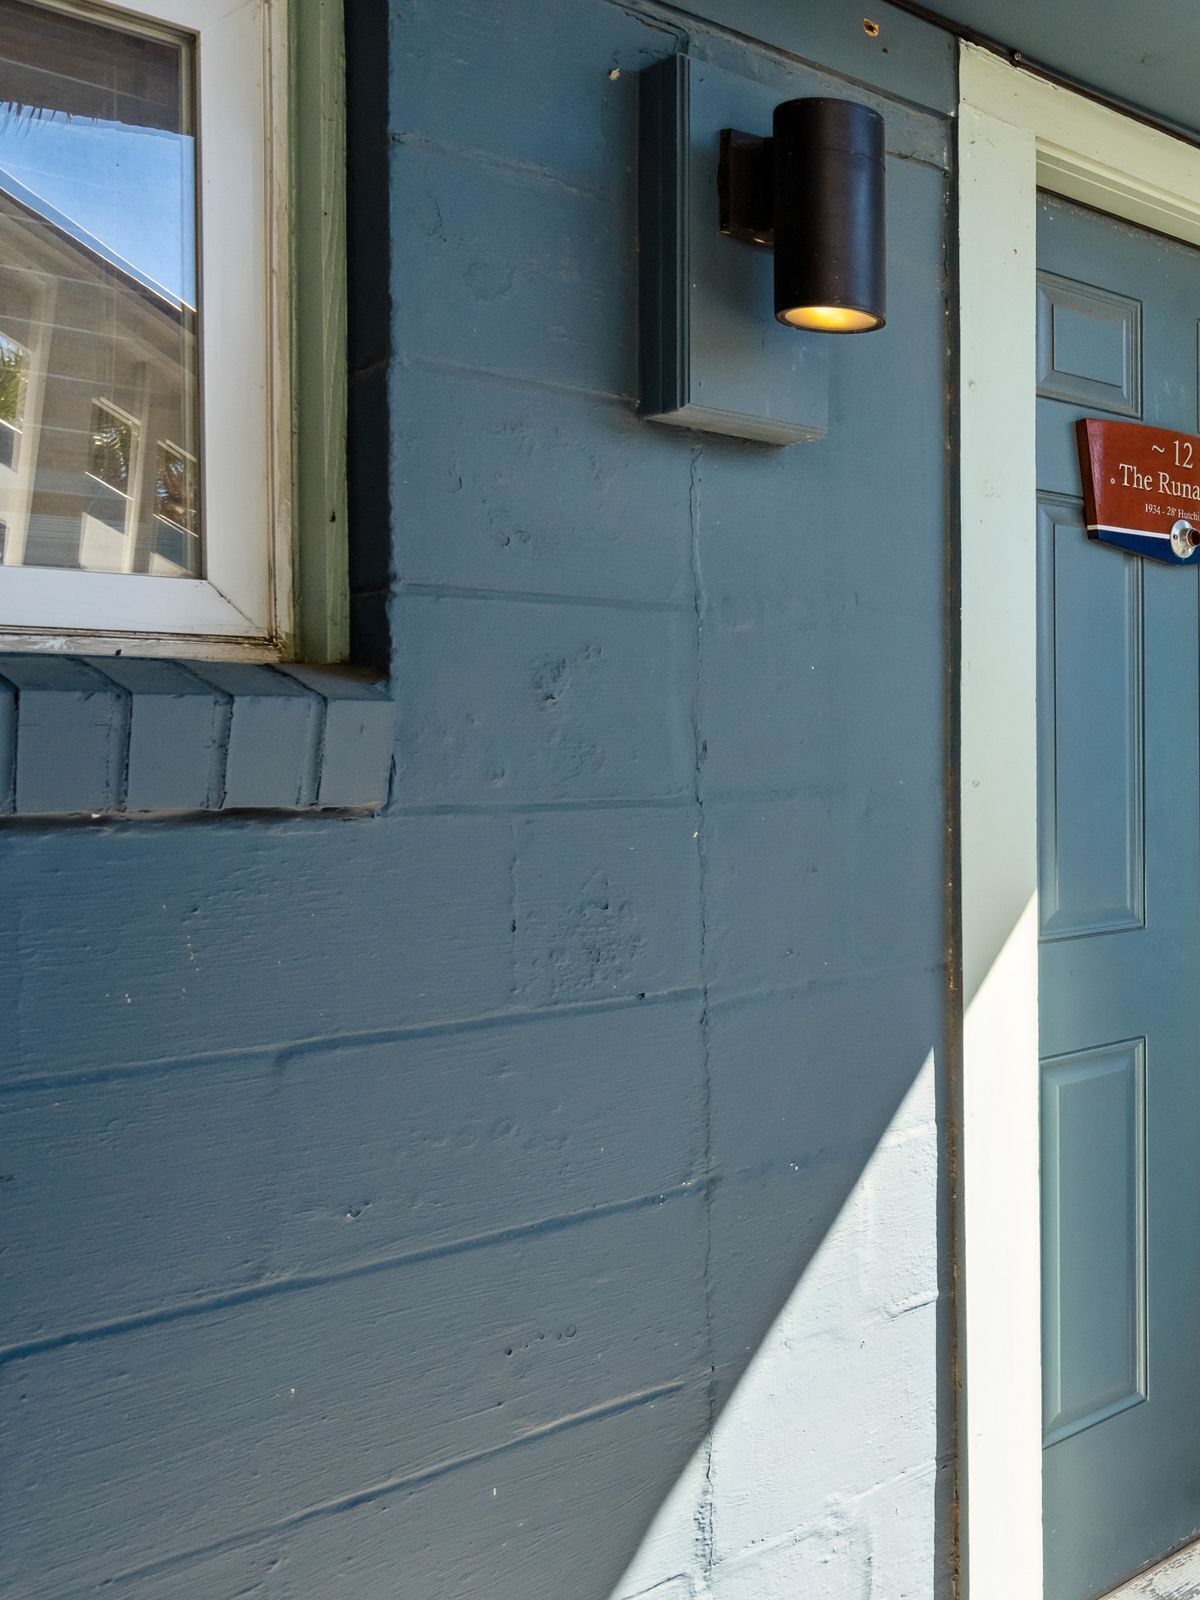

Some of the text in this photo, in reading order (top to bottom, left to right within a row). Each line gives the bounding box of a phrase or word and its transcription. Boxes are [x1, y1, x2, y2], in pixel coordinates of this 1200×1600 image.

[1173, 440, 1193, 469] 12
[1119, 463, 1153, 492] The
[1145, 503, 1161, 515] 1934
